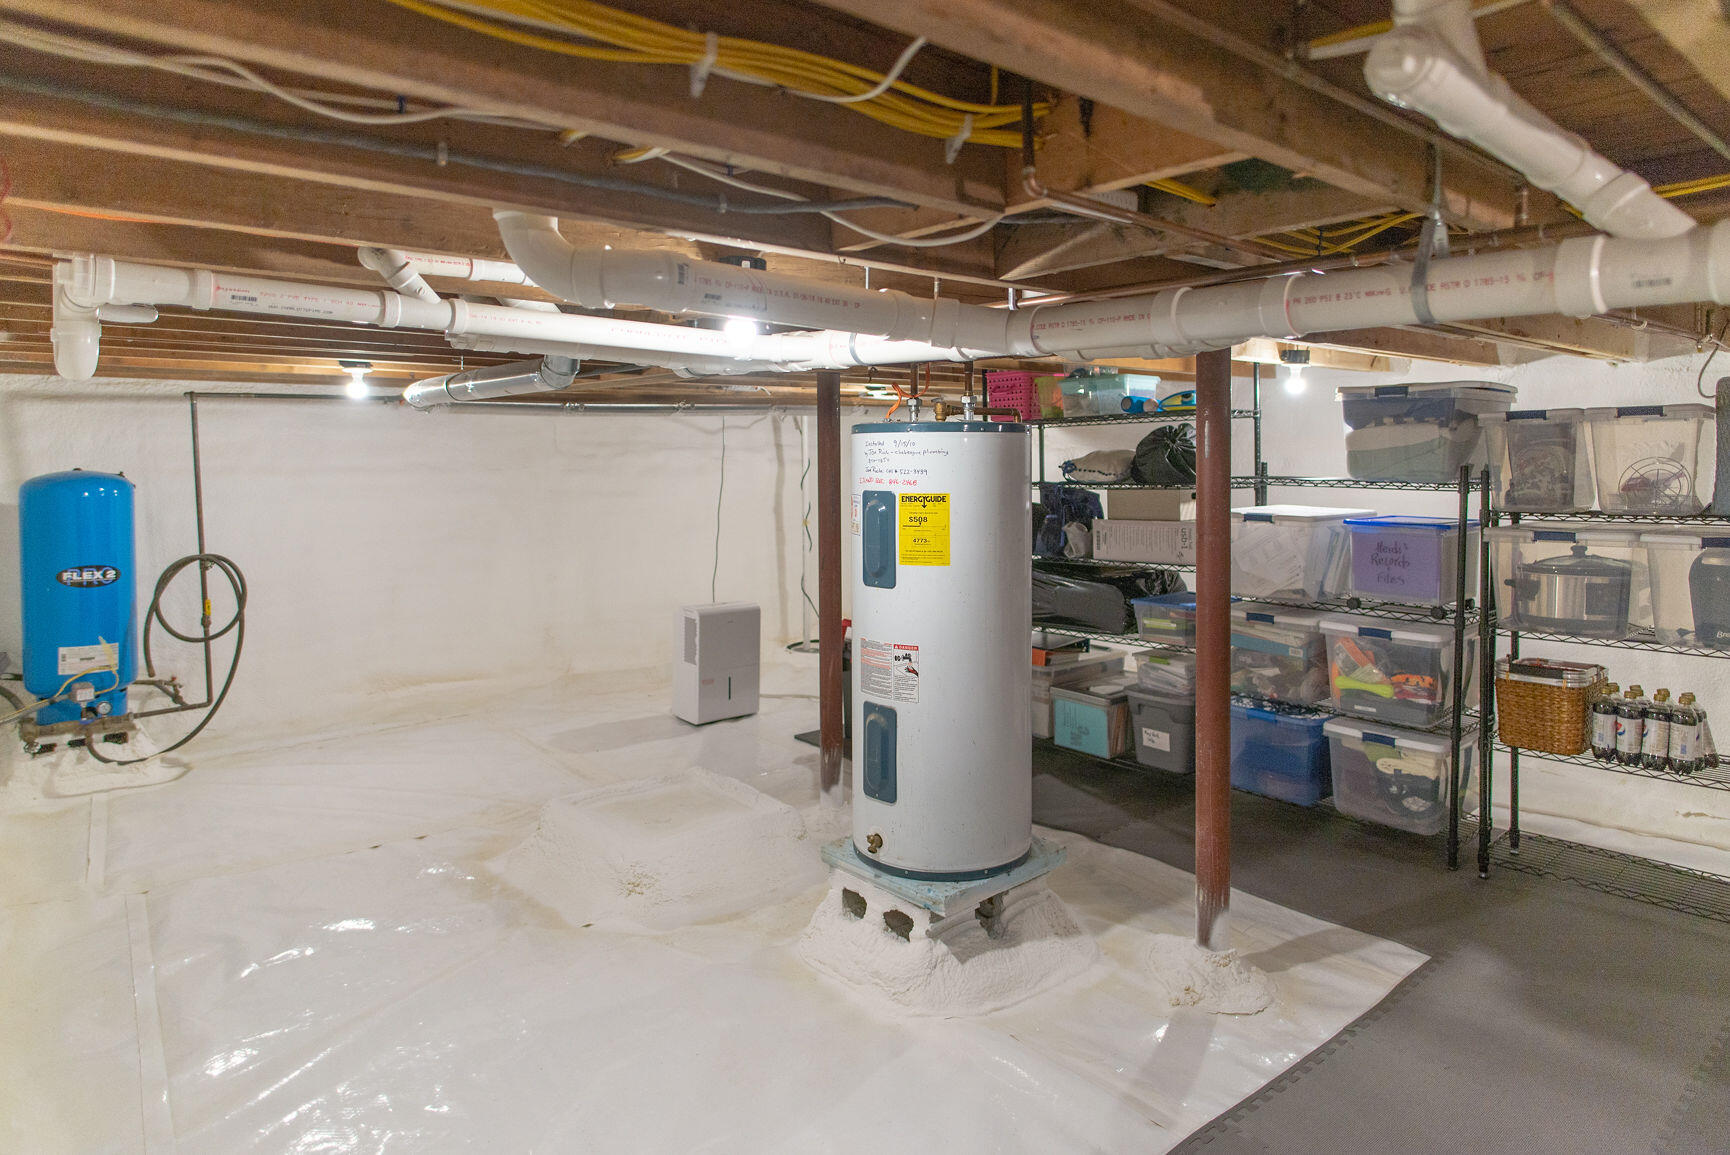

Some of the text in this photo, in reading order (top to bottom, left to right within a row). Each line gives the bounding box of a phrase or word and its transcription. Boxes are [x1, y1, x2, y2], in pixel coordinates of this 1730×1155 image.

[62, 570, 117, 581] FLEX 2
[1375, 571, 1405, 586] Files
